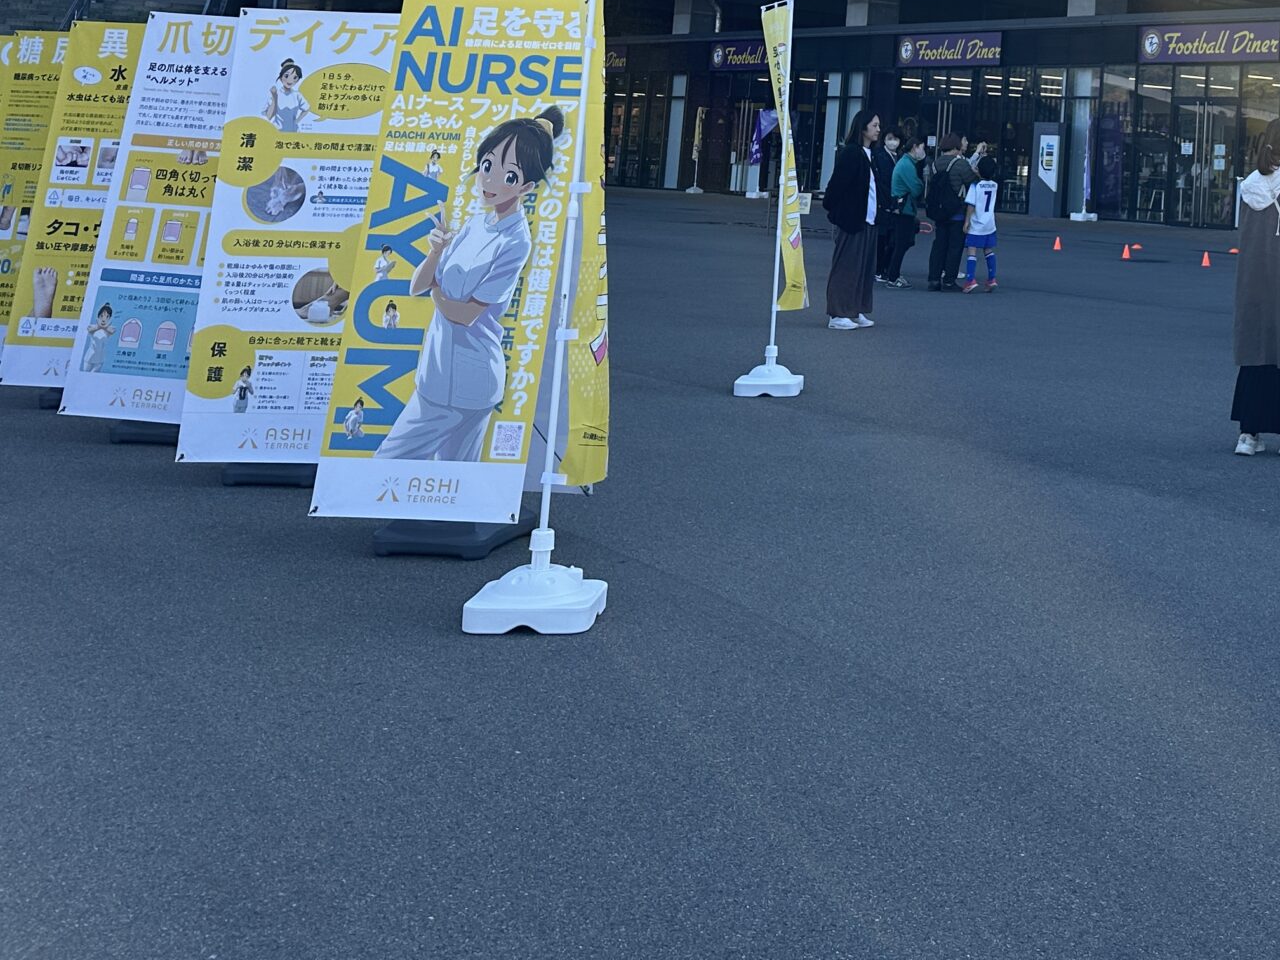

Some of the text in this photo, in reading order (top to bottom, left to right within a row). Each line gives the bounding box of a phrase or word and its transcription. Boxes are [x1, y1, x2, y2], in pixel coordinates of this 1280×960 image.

[402, 4, 465, 48] AI
[467, 6, 583, 39] 足を守る
[98, 28, 130, 60] 異
[157, 20, 235, 57] 爪切
[249, 15, 400, 57] デイケア
[1164, 29, 1280, 56] Football Diner
[724, 47, 764, 65] Football
[916, 38, 1002, 62] Football Diner
[109, 64, 128, 82] 水
[147, 62, 228, 77] 足の爪は体を支える
[393, 50, 584, 97] NURSE
[320, 83, 386, 93] 足をいたわるだけで
[319, 92, 381, 103] 足トラブルの多くは
[390, 93, 465, 112] AIナース
[317, 102, 351, 112] 防げます。
[387, 110, 464, 130] あっちゃん
[385, 129, 462, 142] ADACHI AYUMI
[382, 140, 459, 154] 足は健康の土台
[155, 168, 217, 183] 四角く切って
[162, 183, 208, 199] 角は丸く
[328, 153, 450, 452] AYUMI
[131, 388, 172, 403] ASHI
[130, 401, 169, 411] TERRACE
[265, 427, 312, 442] ASHI
[264, 441, 310, 451] TERRACE
[406, 477, 461, 494] ASHI
[406, 494, 457, 505] TERRACE
